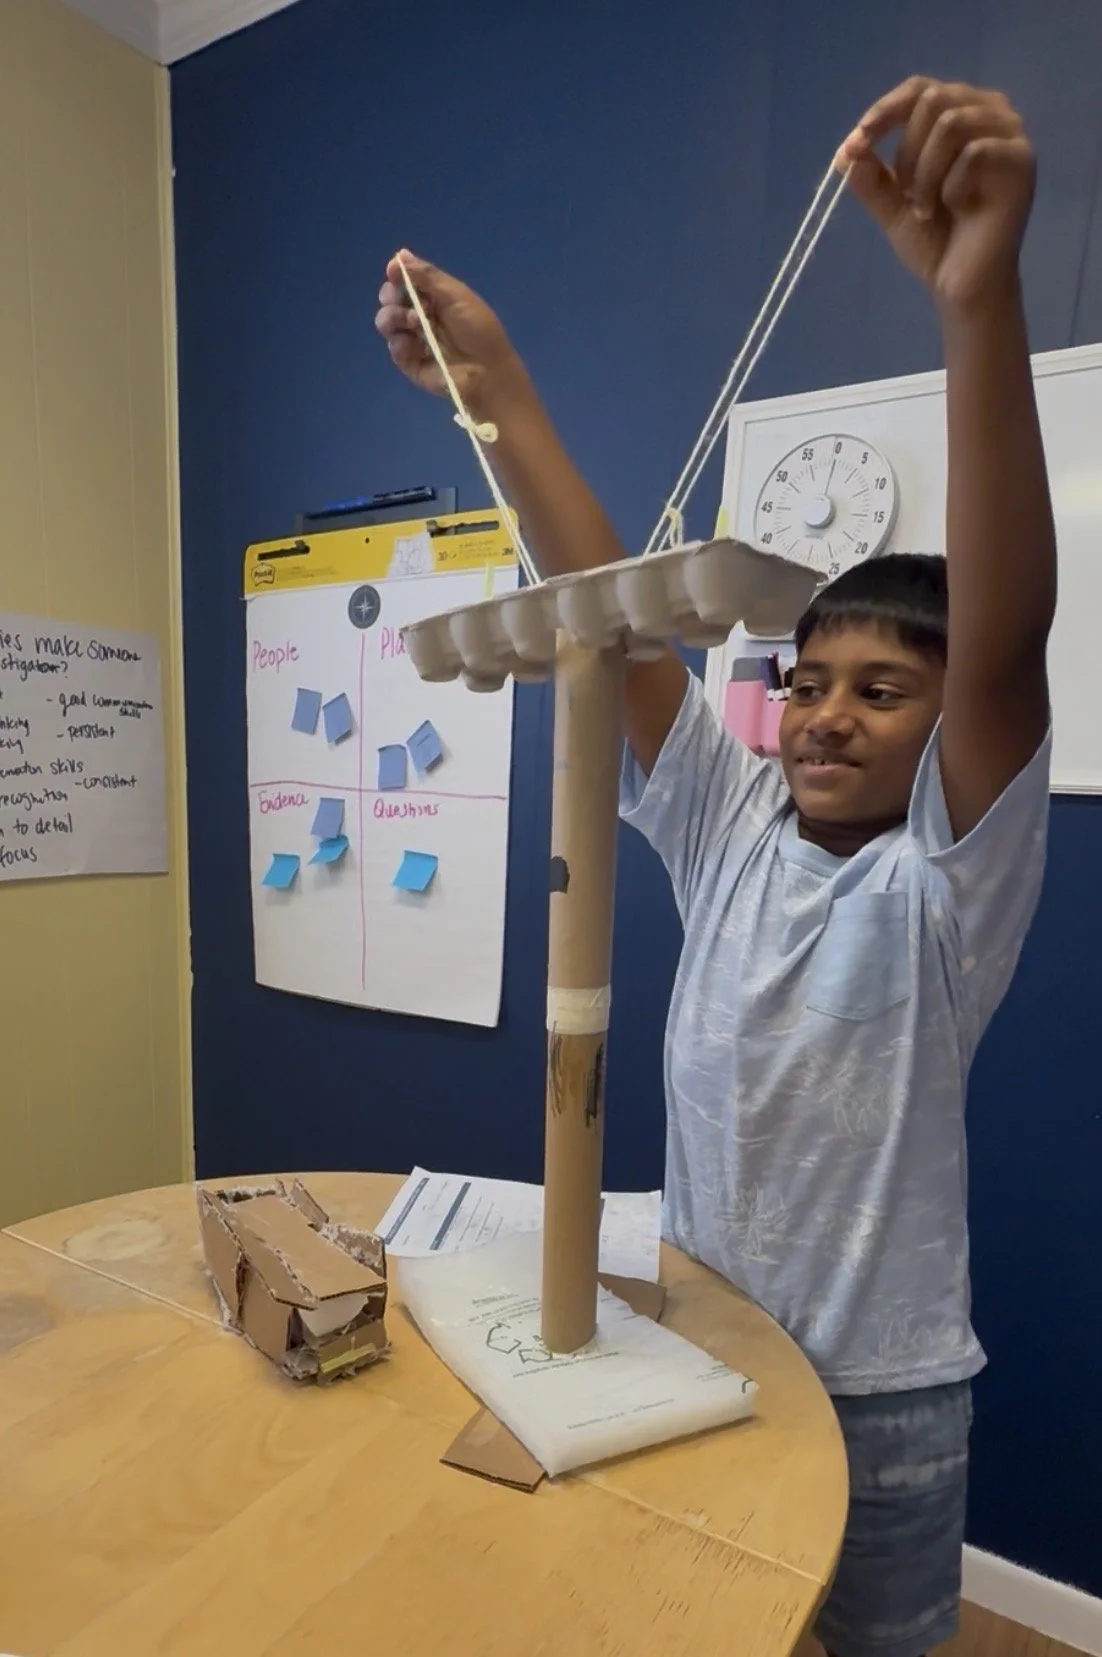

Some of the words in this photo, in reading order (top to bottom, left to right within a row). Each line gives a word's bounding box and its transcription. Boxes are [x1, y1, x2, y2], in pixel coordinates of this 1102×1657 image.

[801, 448, 815, 461] 55
[834, 442, 842, 454] 0
[861, 452, 869, 464] 5
[776, 470, 789, 483] 50
[874, 477, 887, 490] 10
[761, 501, 773, 513] 45
[873, 511, 885, 523] 15
[760, 532, 773, 545] 40
[855, 542, 869, 554] 20
[829, 562, 841, 575] 25
[35, 635, 83, 657] make
[252, 640, 299, 673] People
[50, 758, 84, 775] skills
[258, 787, 309, 816] Evidence
[373, 799, 441, 819] Questions
[13, 819, 29, 835] to
[36, 812, 73, 834] detail
